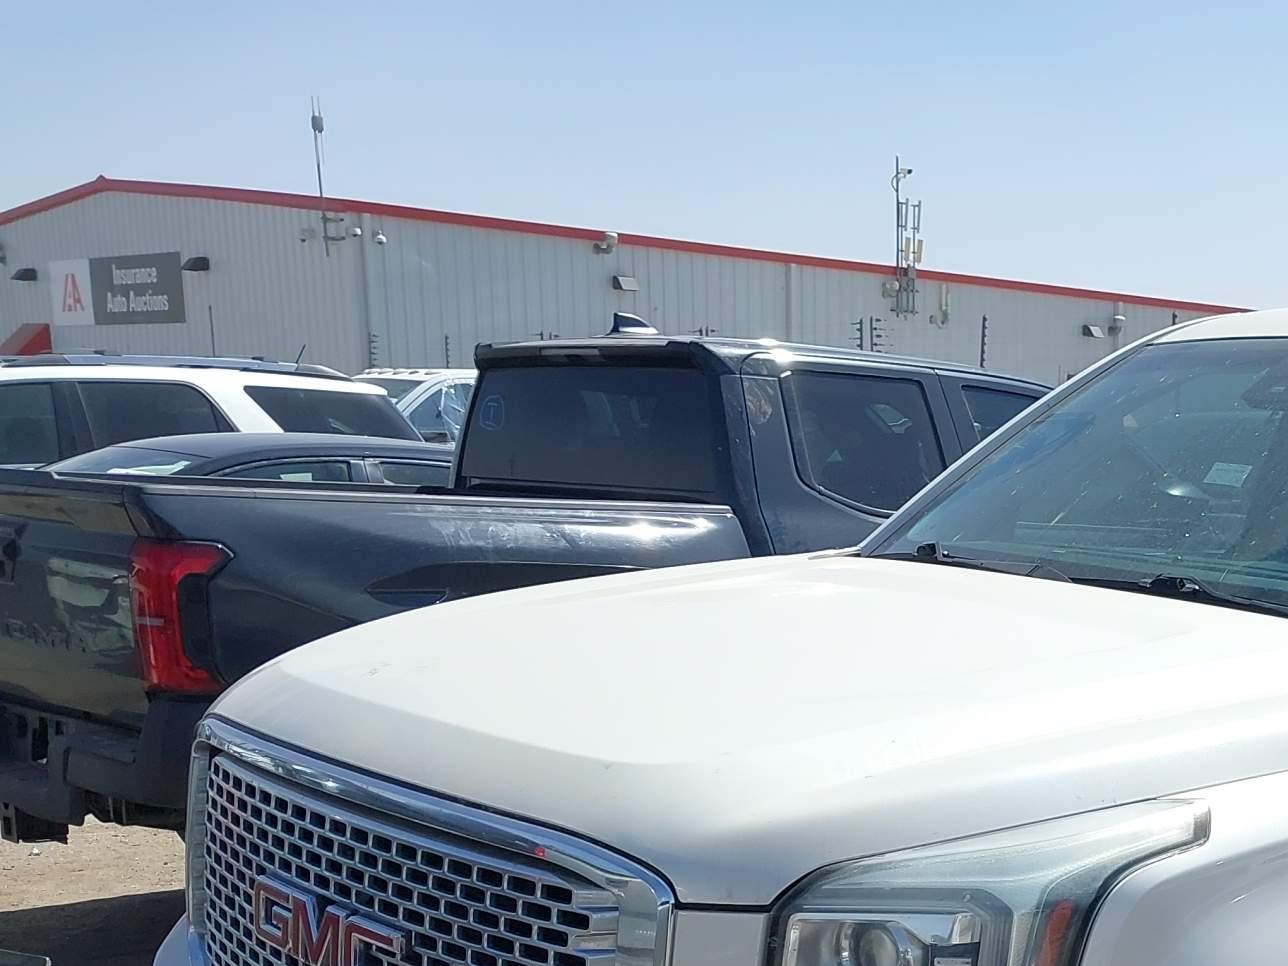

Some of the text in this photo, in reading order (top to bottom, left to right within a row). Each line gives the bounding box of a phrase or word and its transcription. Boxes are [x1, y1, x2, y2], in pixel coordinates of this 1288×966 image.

[112, 264, 158, 285] Insurance
[107, 290, 169, 312] Auto Auctions
